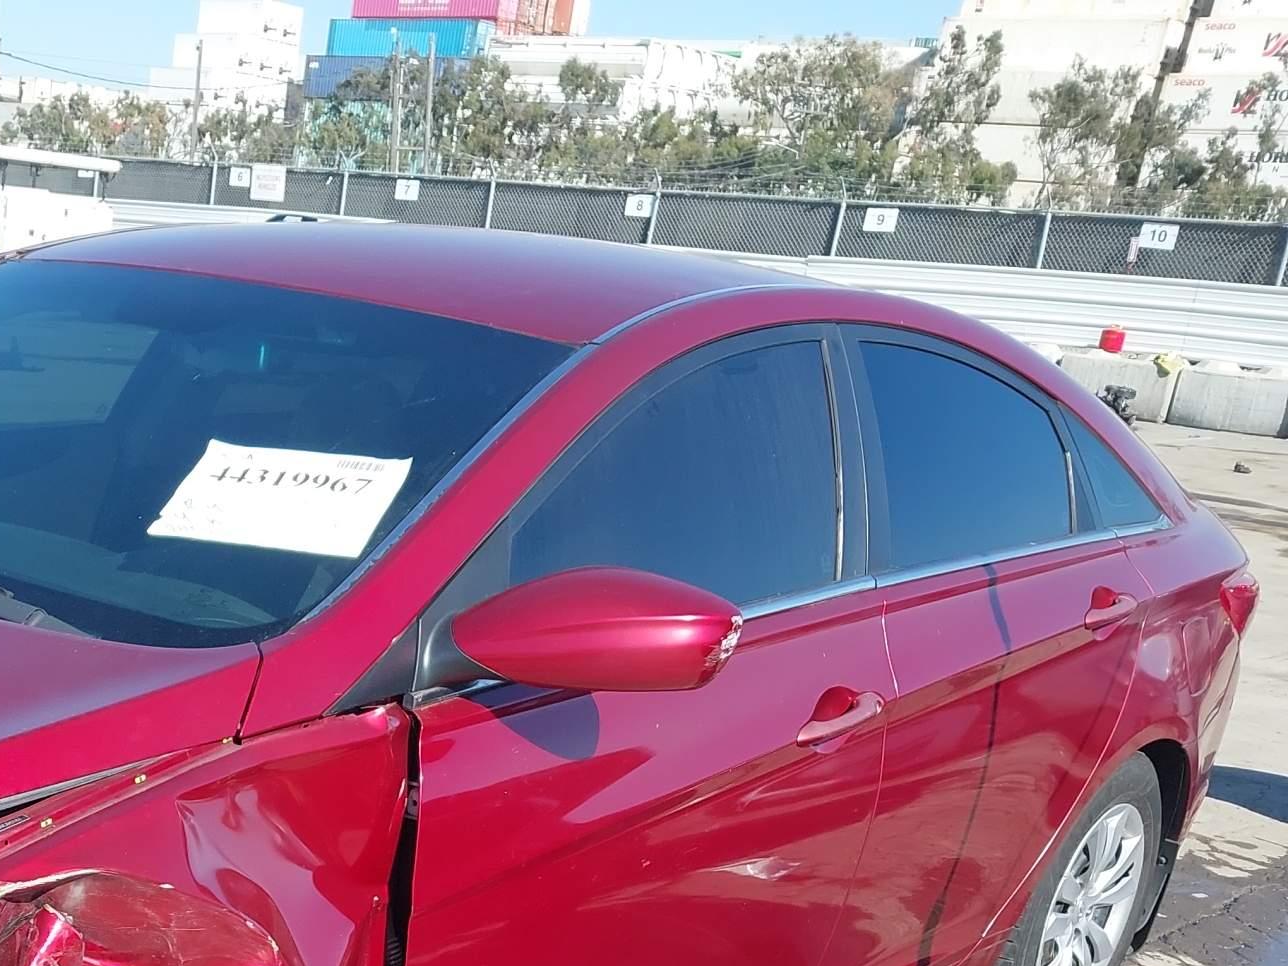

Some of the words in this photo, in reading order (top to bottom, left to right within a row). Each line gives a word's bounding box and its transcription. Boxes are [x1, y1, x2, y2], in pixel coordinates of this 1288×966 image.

[1205, 22, 1236, 31] seaco
[1175, 79, 1206, 87] seaco
[237, 171, 244, 182] 6
[404, 184, 411, 196] 7
[636, 199, 644, 211] 8
[876, 213, 885, 226] 9
[1150, 229, 1168, 243] 10
[209, 466, 374, 495] 44319967
